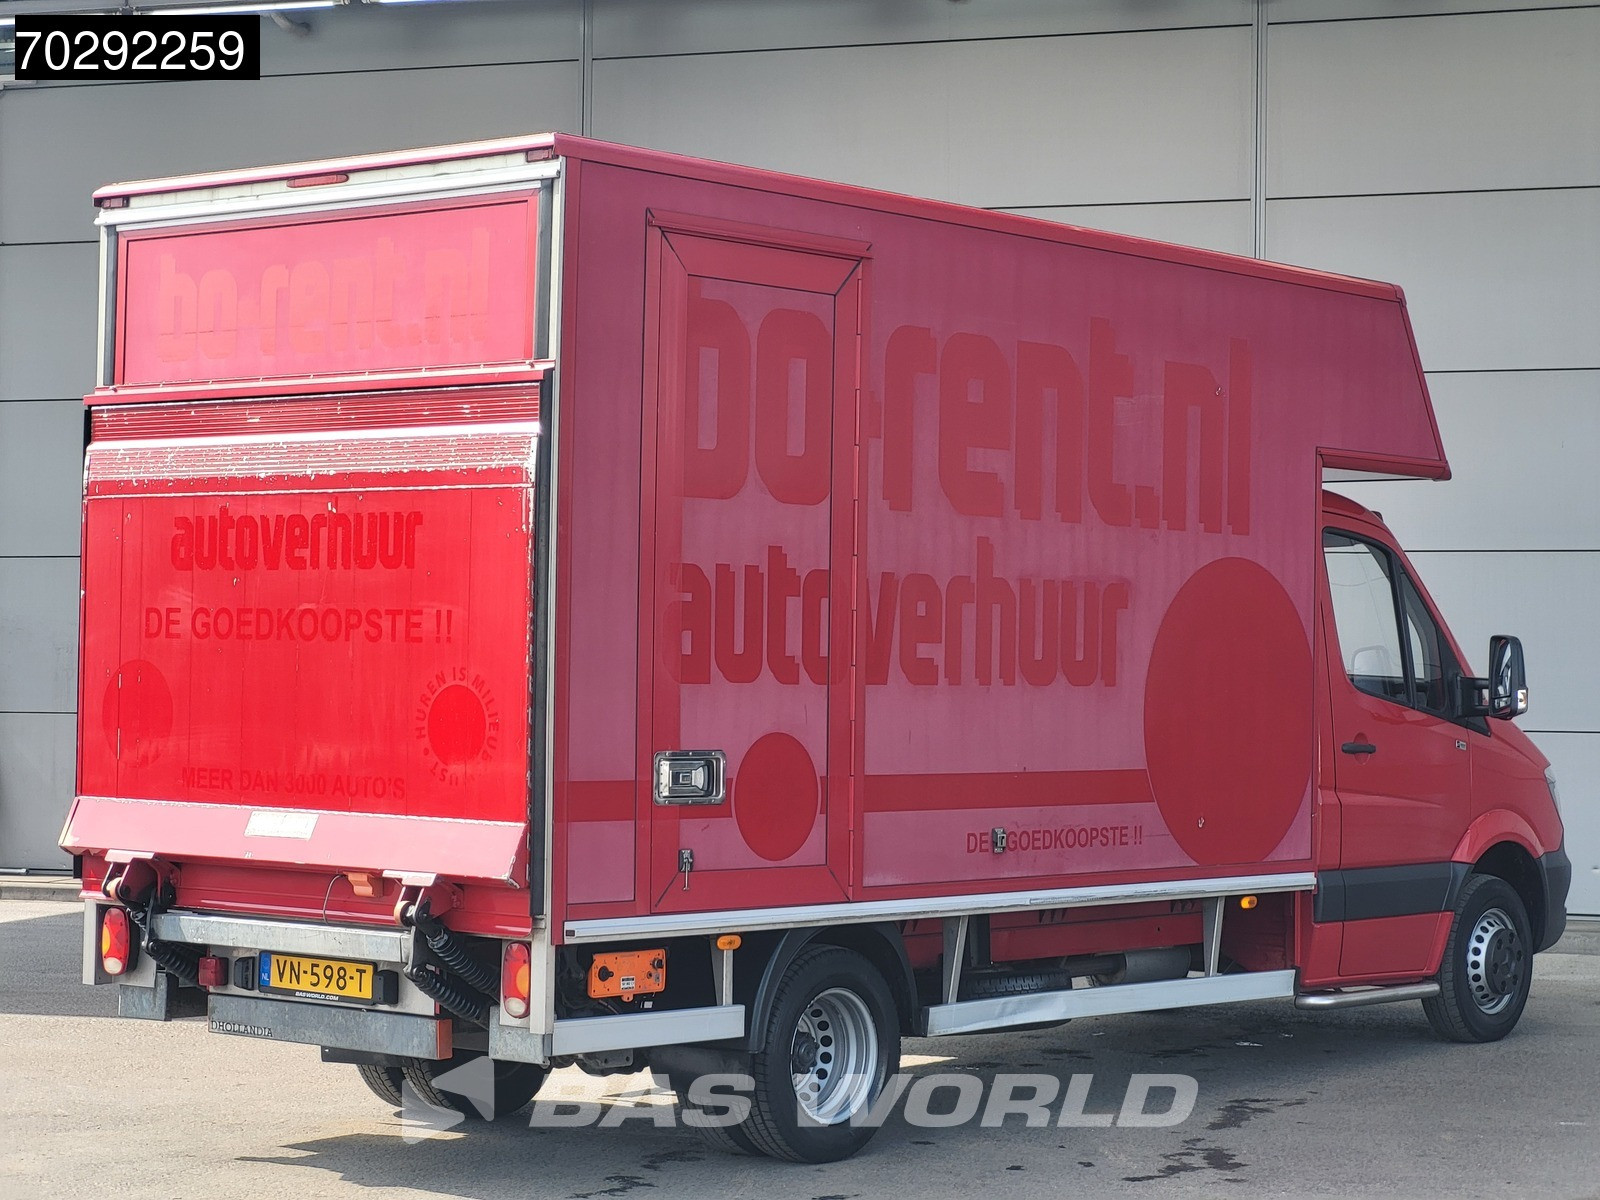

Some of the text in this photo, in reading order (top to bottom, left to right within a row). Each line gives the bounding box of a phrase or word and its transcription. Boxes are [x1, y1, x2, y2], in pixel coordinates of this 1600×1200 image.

[157, 227, 490, 362] bo-rent.nl
[170, 496, 423, 571] autoverhuur
[144, 606, 453, 643] DE GOEDKOOPSTE !!
[662, 536, 1129, 687] autoverhuur
[415, 670, 447, 740] HUREN
[452, 666, 467, 682] IS
[181, 766, 234, 791] MEER
[239, 769, 279, 793] DAN
[331, 774, 406, 800] AUTO'S
[966, 825, 1143, 854] DE GOEDKOOPSTE !!
[261, 972, 270, 981] NL
[276, 958, 367, 993] VN-598-T
[210, 1019, 273, 1037] DHOLLANDIA
